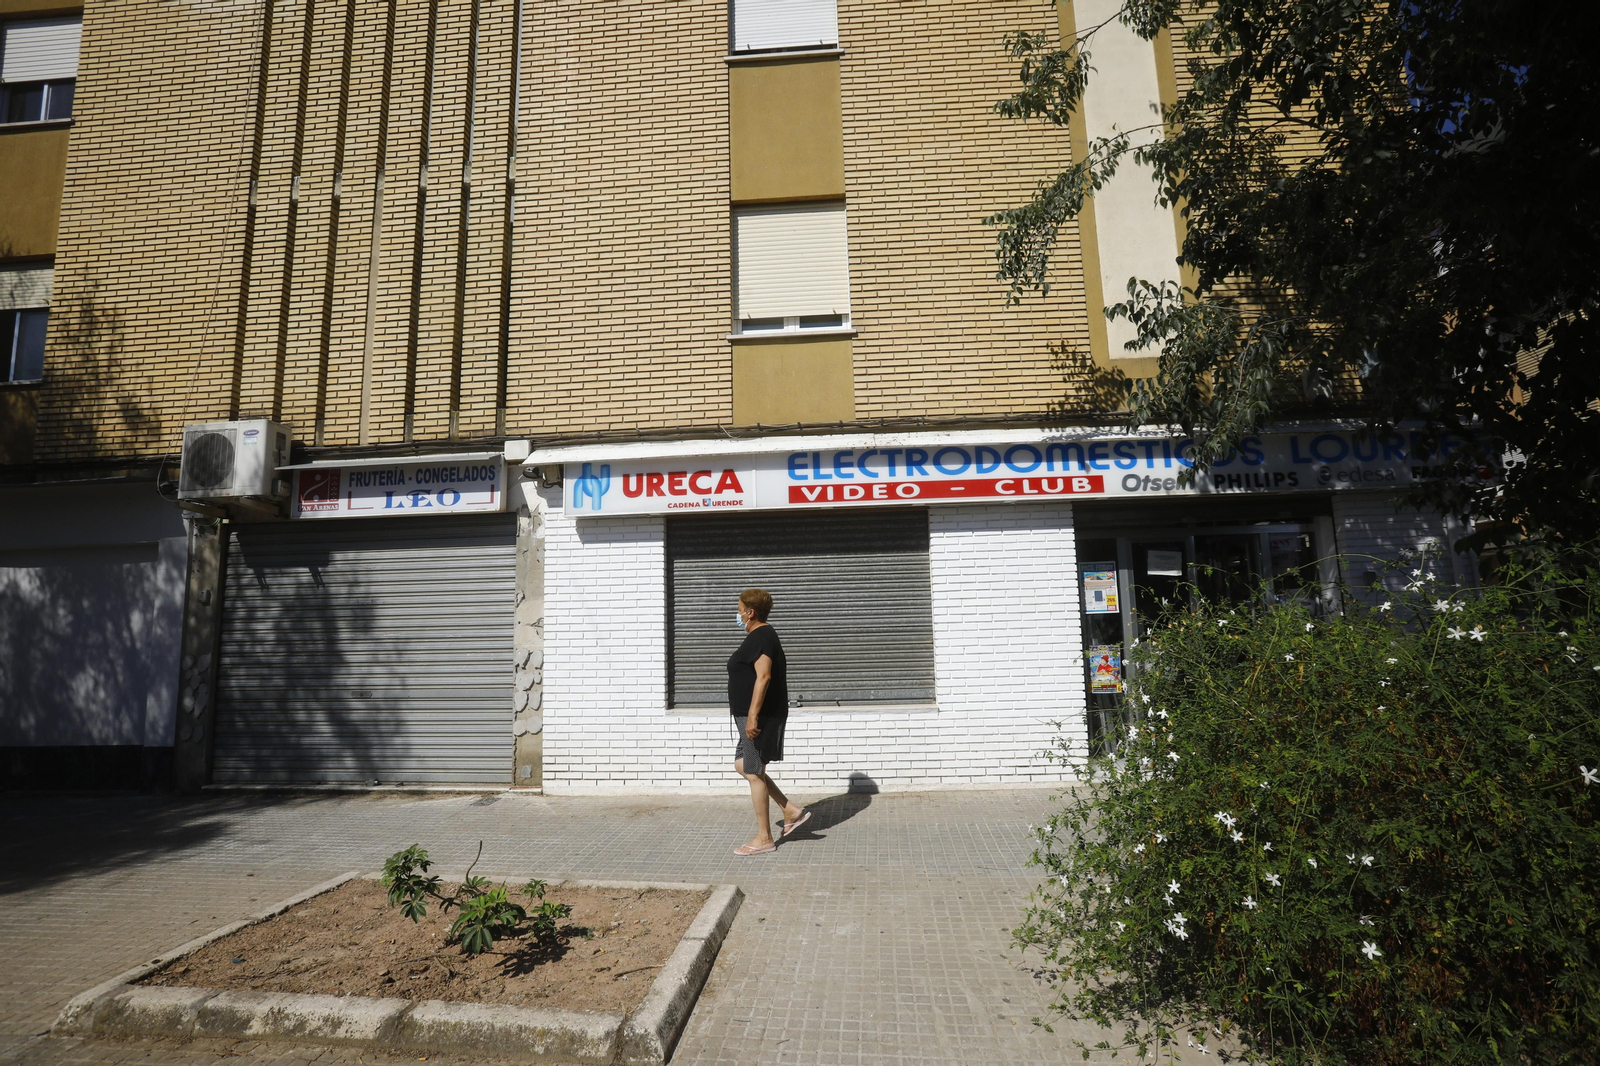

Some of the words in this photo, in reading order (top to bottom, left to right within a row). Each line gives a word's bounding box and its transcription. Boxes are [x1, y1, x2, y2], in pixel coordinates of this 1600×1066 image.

[1290, 428, 1492, 464] LOURE
[349, 466, 405, 488] FRUTERÍA
[415, 465, 496, 484] CONGELADOS
[622, 468, 744, 498] URECA
[1214, 471, 1299, 489] PHILIPS
[1337, 467, 1396, 483] edesa
[1411, 465, 1471, 479] FAG
[382, 487, 461, 509] LEO
[800, 483, 921, 502] VIDEO
[994, 477, 1092, 495] CLUB
